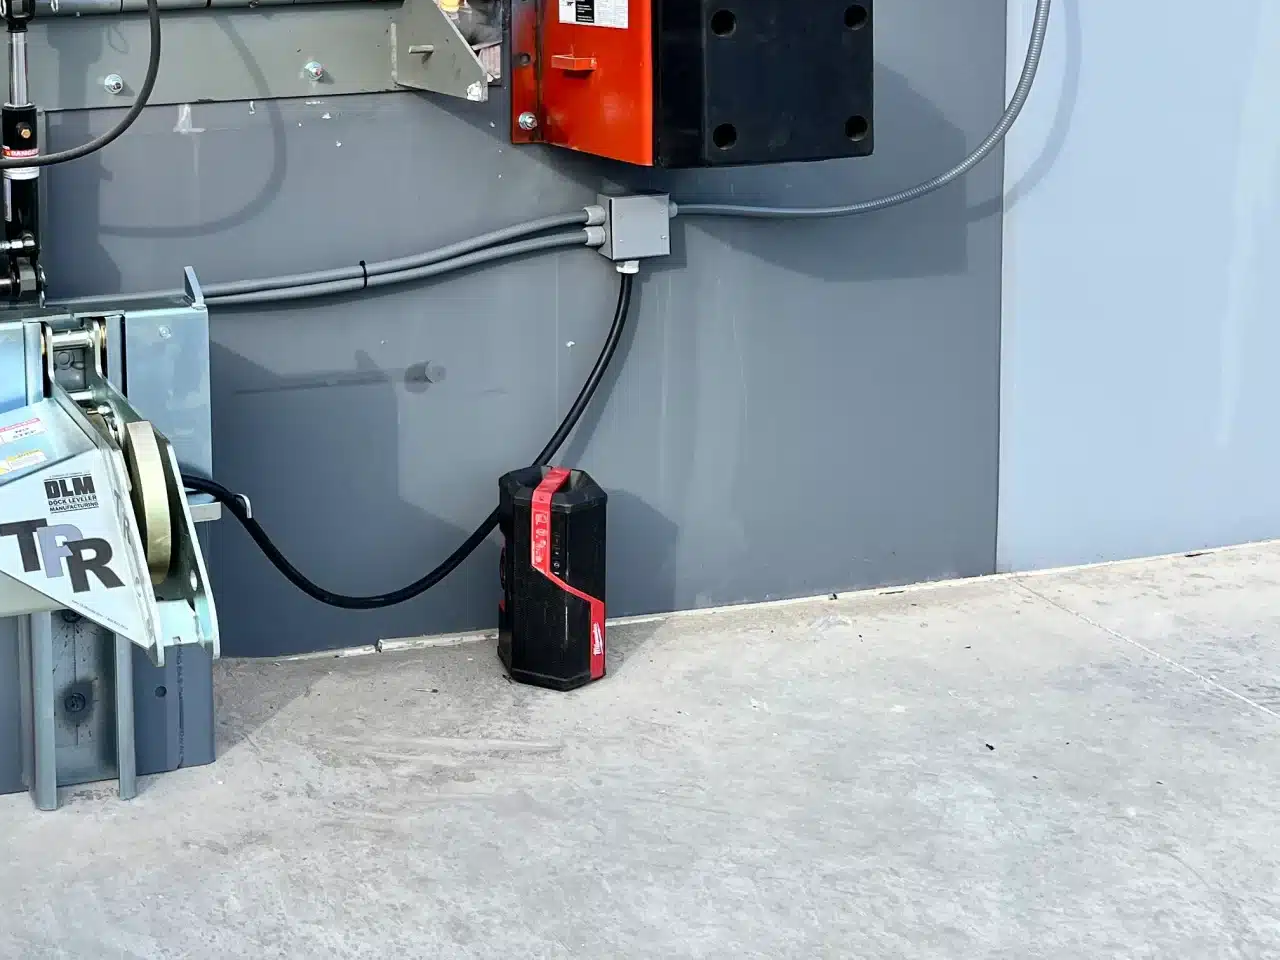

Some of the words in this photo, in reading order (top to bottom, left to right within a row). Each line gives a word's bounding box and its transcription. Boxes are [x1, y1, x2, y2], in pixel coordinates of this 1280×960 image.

[44, 476, 95, 499] DLM
[68, 495, 97, 504] LEVELER
[49, 501, 99, 511] MANUFACTURING
